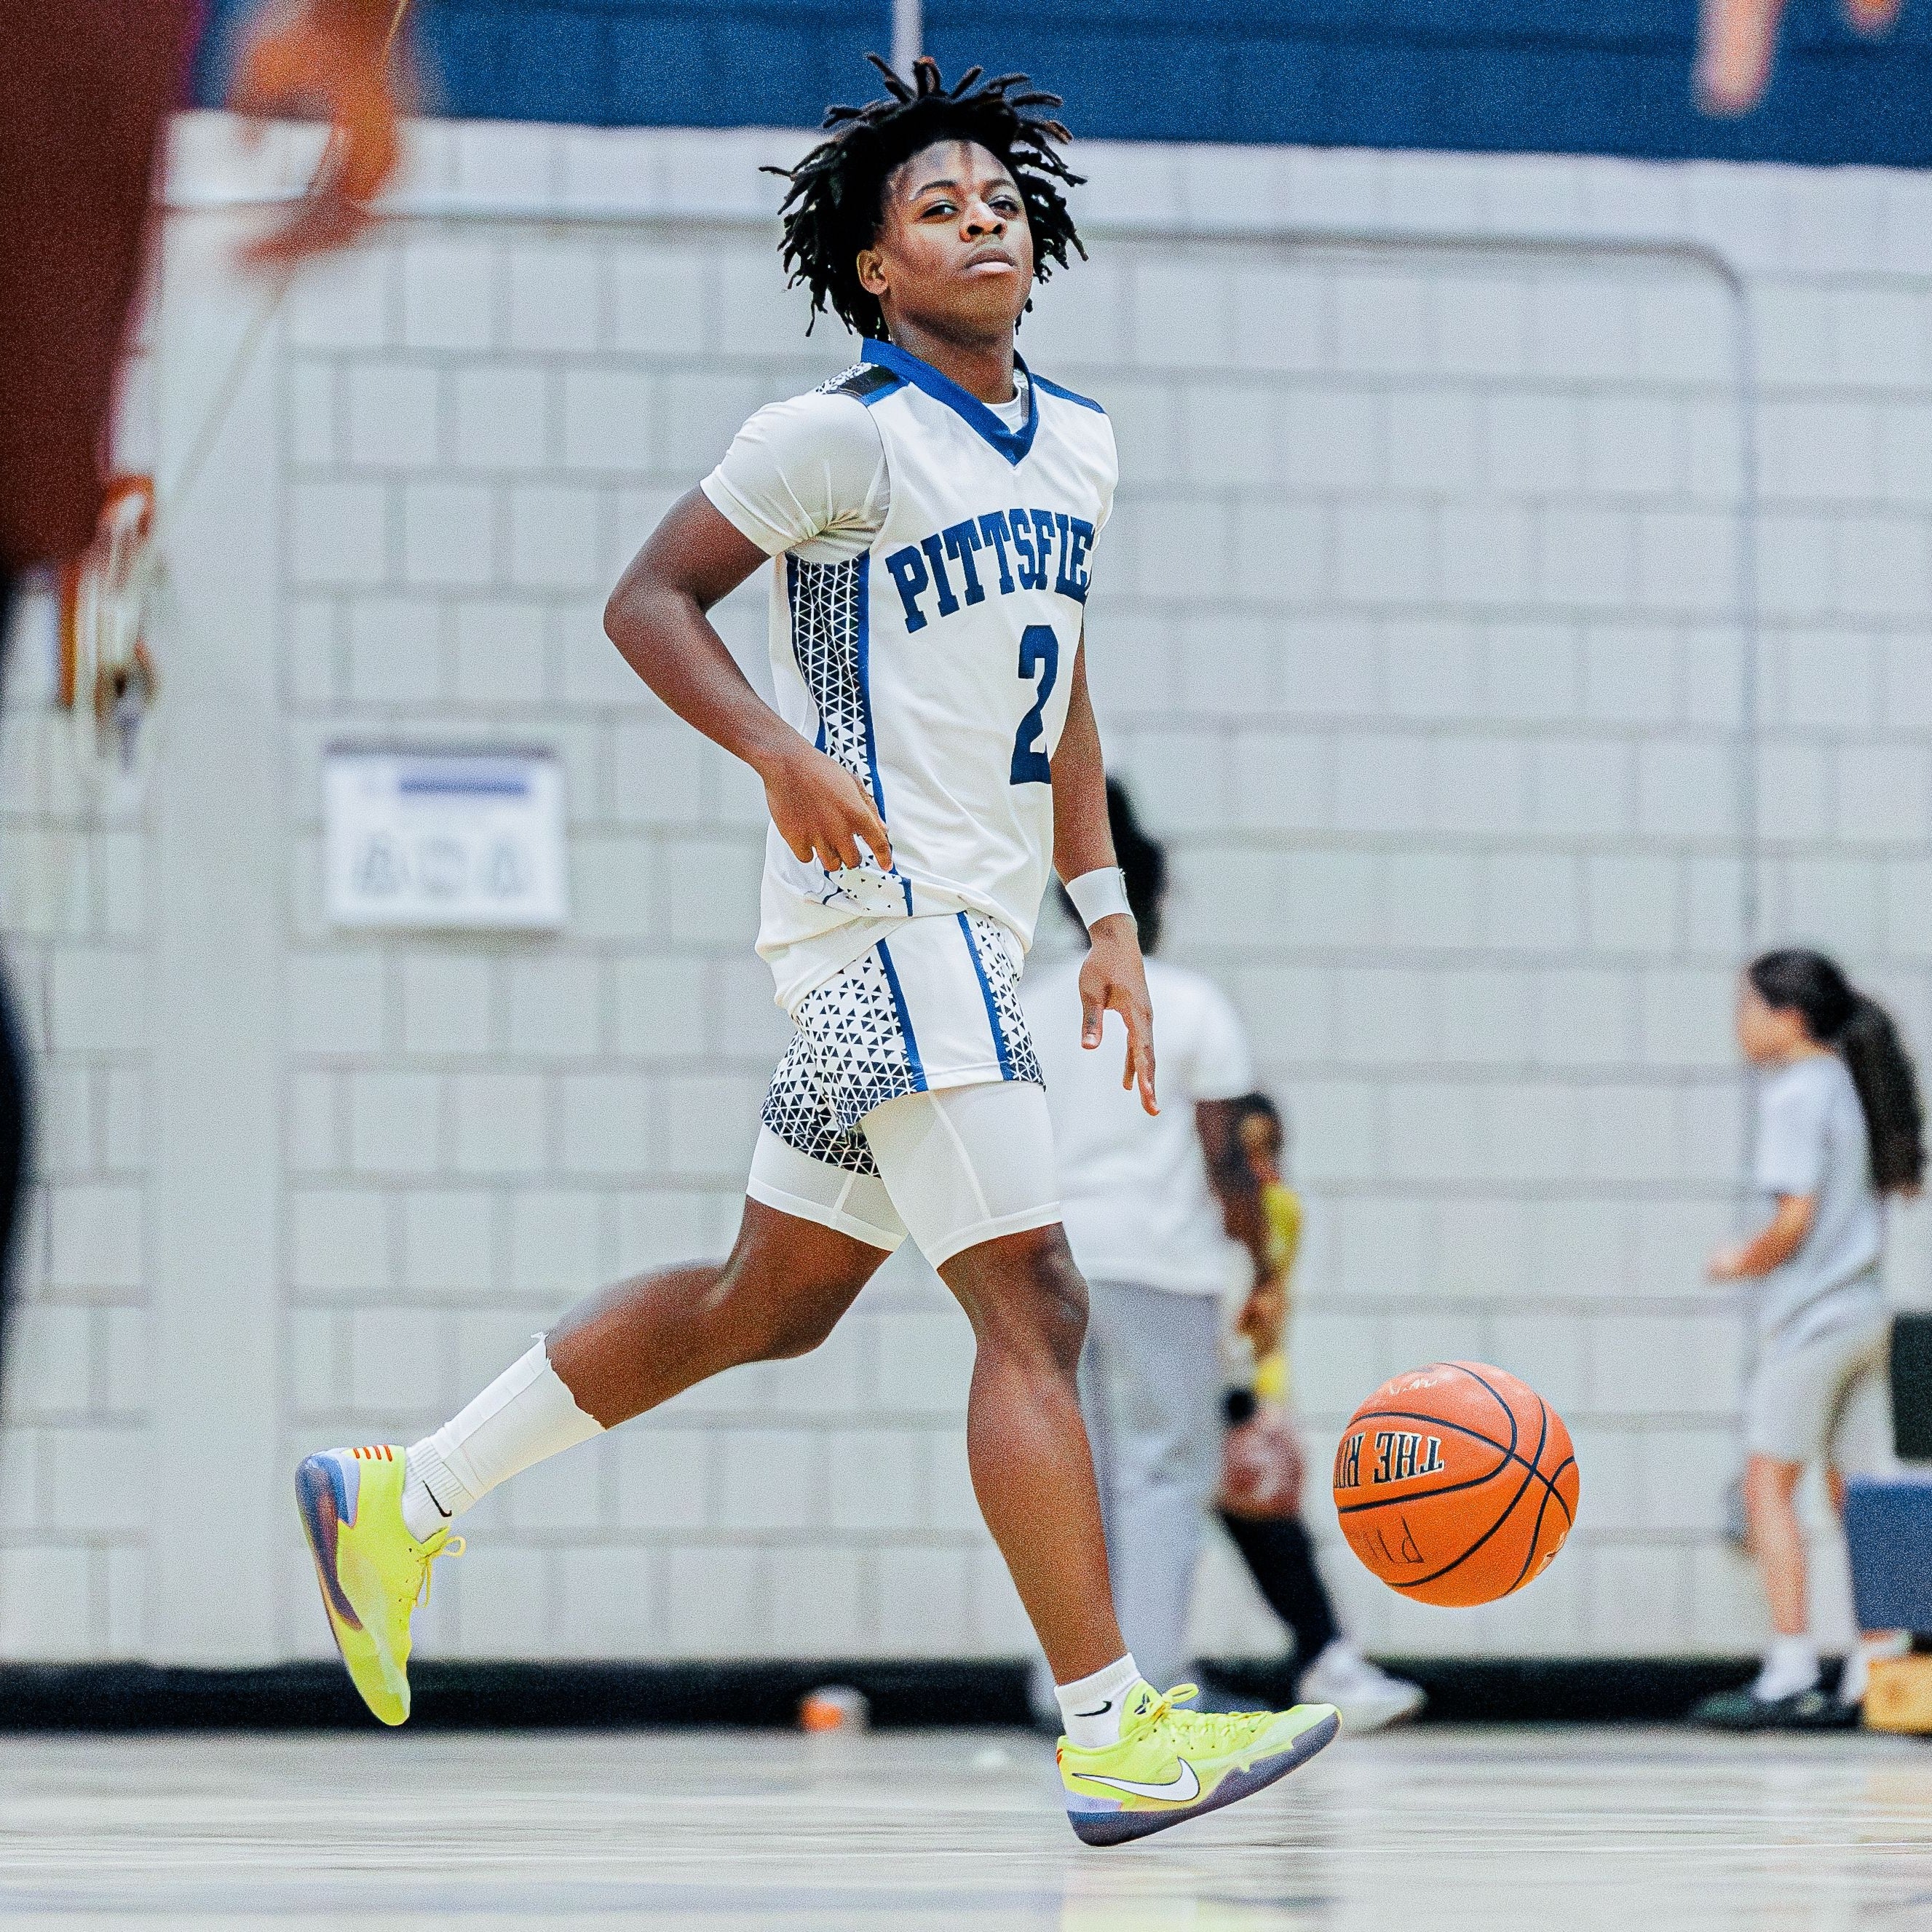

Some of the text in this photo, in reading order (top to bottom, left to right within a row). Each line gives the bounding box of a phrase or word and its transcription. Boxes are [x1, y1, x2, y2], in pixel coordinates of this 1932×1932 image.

[885, 509, 1094, 634] PITTSFIE
[1010, 625, 1059, 785] 2
[1374, 1431, 1445, 1484] THE
